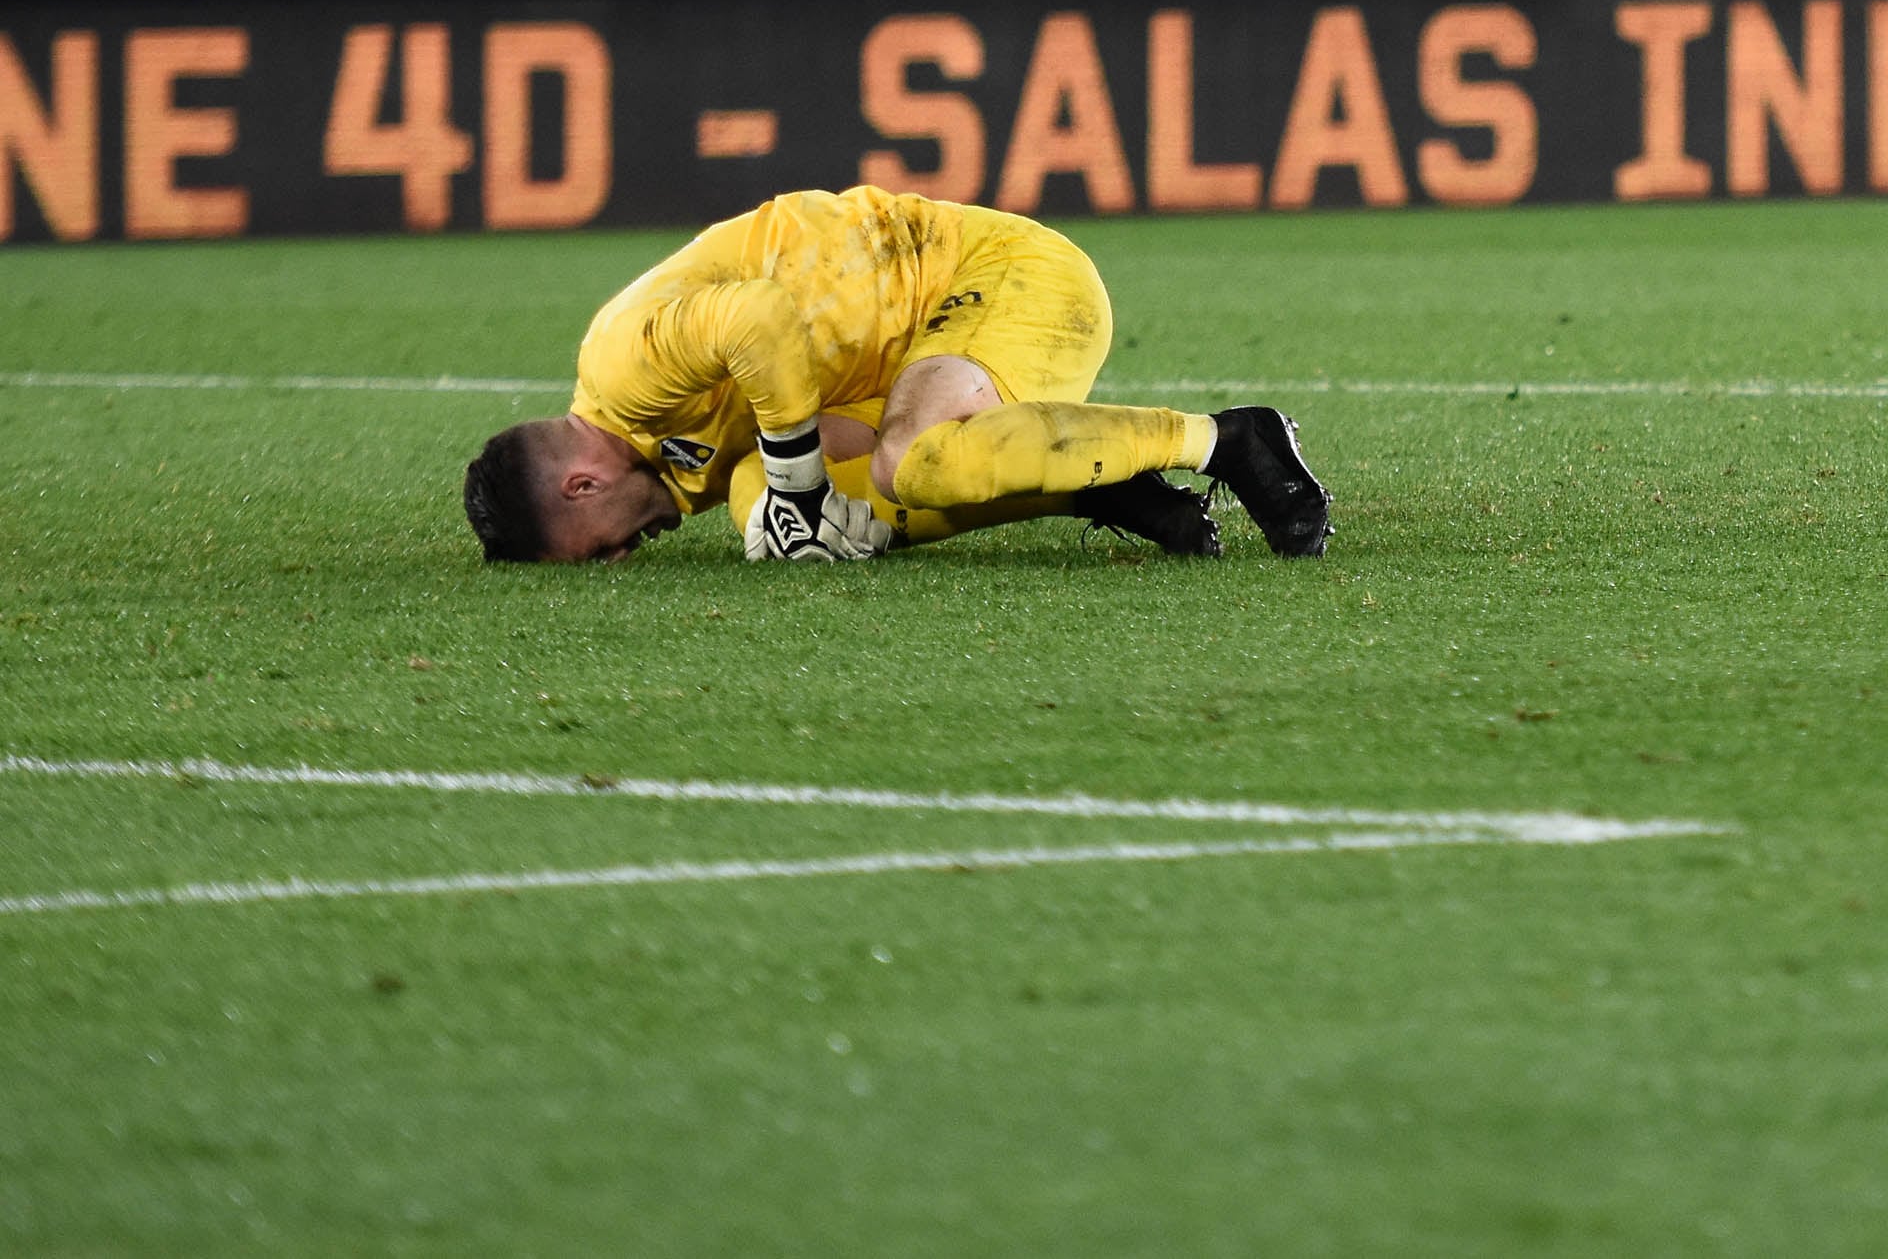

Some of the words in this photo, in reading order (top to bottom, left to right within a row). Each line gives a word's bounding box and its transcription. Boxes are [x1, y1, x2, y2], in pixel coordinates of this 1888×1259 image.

[0, 26, 251, 243] NE
[323, 21, 612, 232] 4D
[697, 109, 777, 157] -
[857, 3, 1538, 213] SALAS
